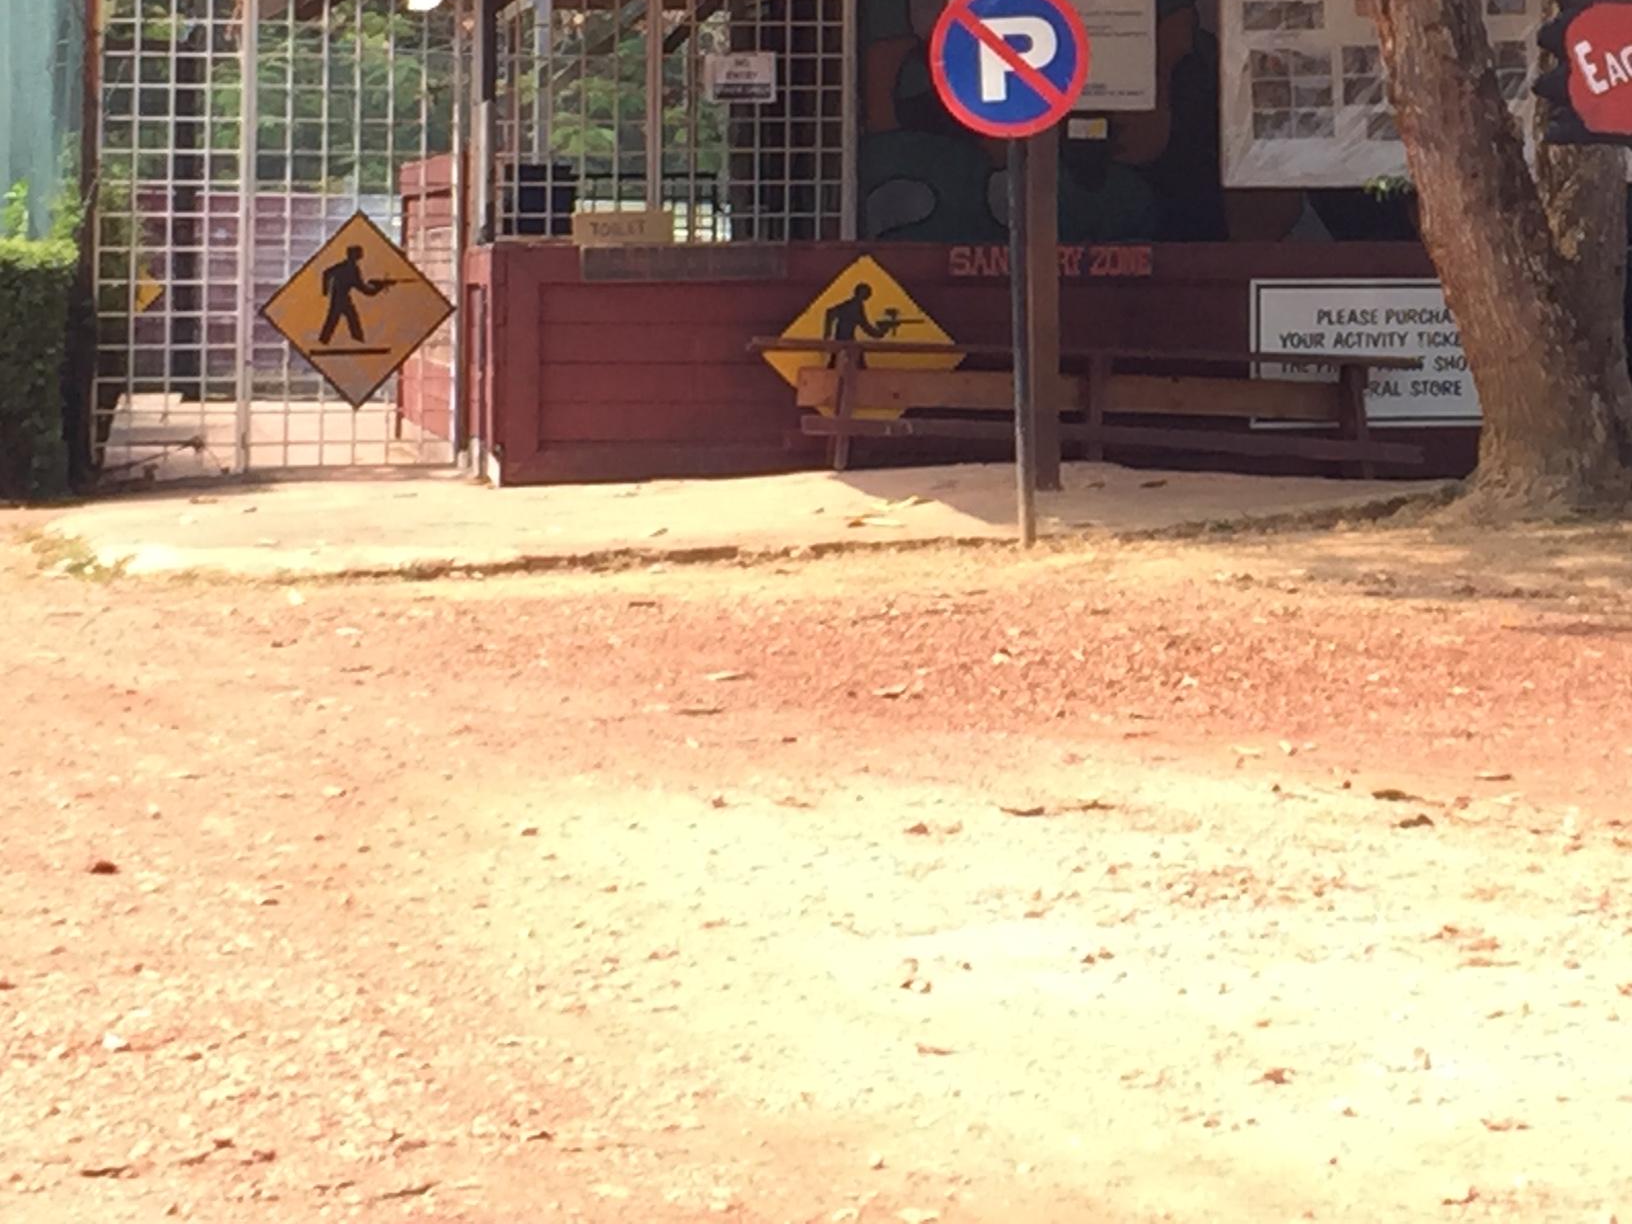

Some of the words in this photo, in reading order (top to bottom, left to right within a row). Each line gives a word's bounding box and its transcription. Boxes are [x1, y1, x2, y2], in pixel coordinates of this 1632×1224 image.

[979, 15, 1058, 103] P
[1090, 245, 1152, 276] ZONE
[1317, 309, 1379, 326] PLEASE
[1386, 309, 1455, 326] PURCHA
[1280, 332, 1325, 349] YOUR
[1333, 332, 1409, 349] ACTIVITY
[1418, 332, 1462, 347] TICKE
[1433, 355, 1468, 373] SHO
[1410, 381, 1462, 397] STORE
